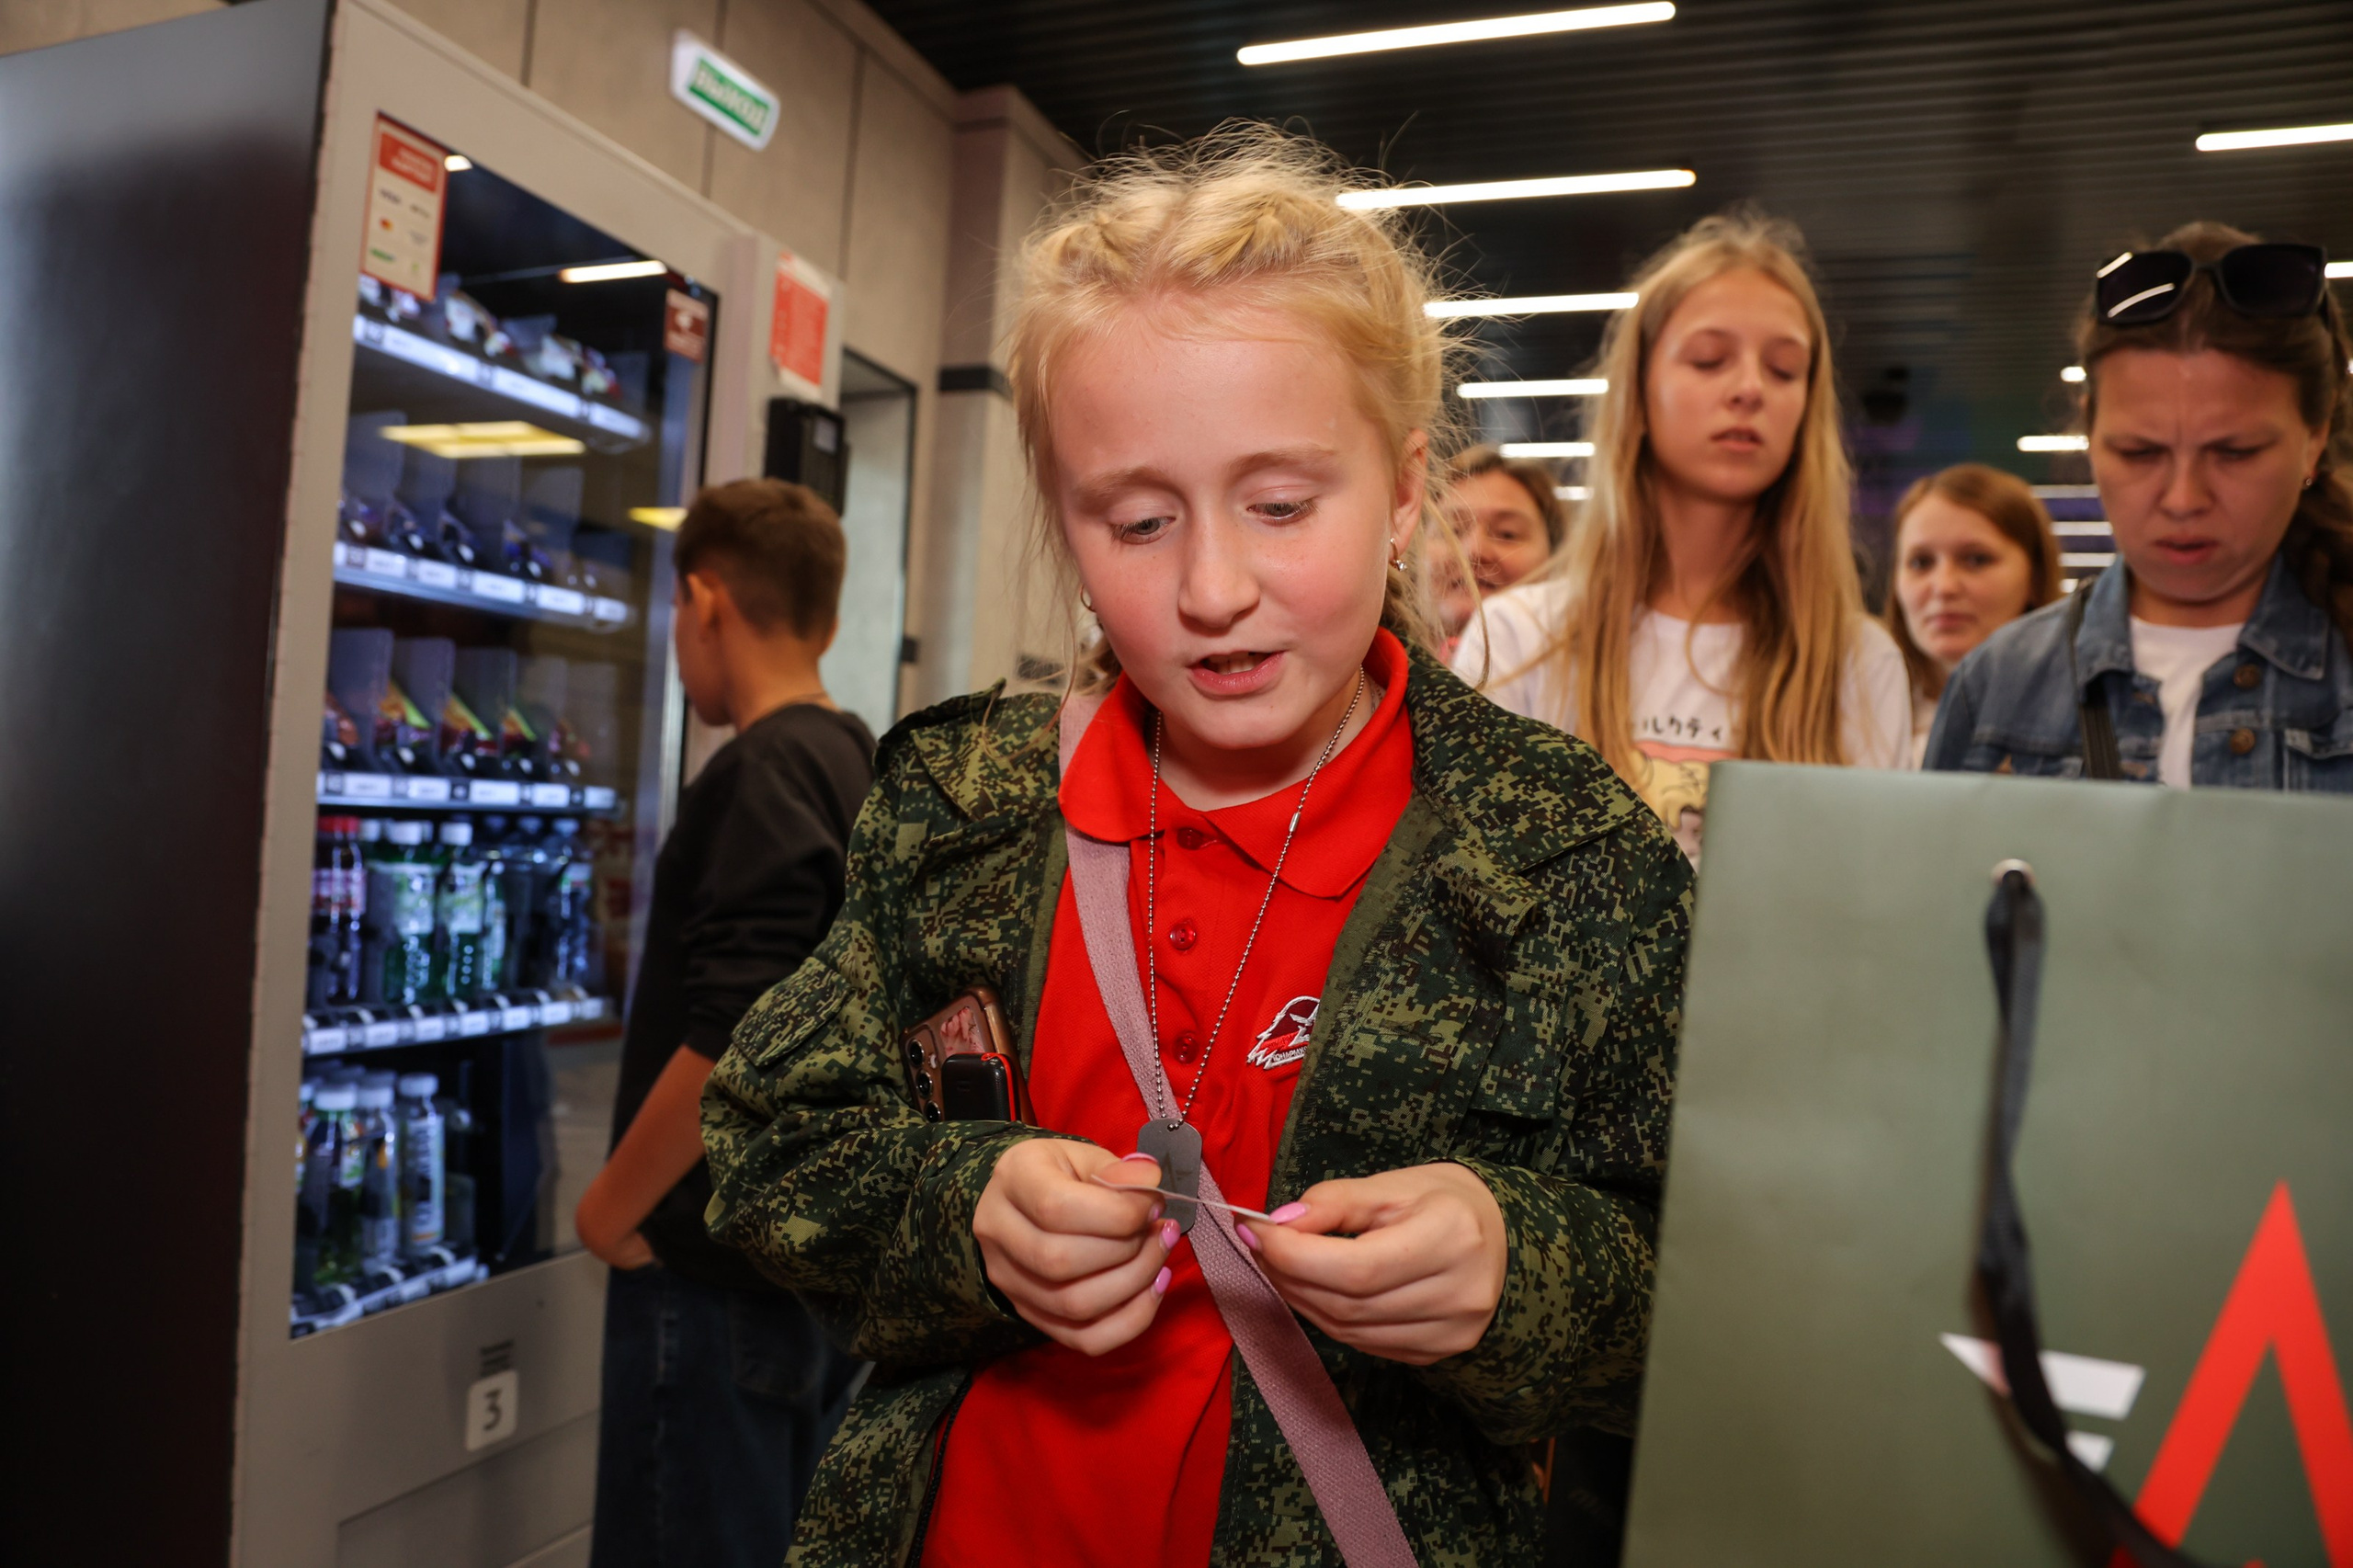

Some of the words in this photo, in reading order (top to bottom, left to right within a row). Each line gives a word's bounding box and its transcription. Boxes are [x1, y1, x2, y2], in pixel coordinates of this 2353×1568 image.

[1629, 713, 1737, 742] ルクティ
[483, 1388, 502, 1431] 3
